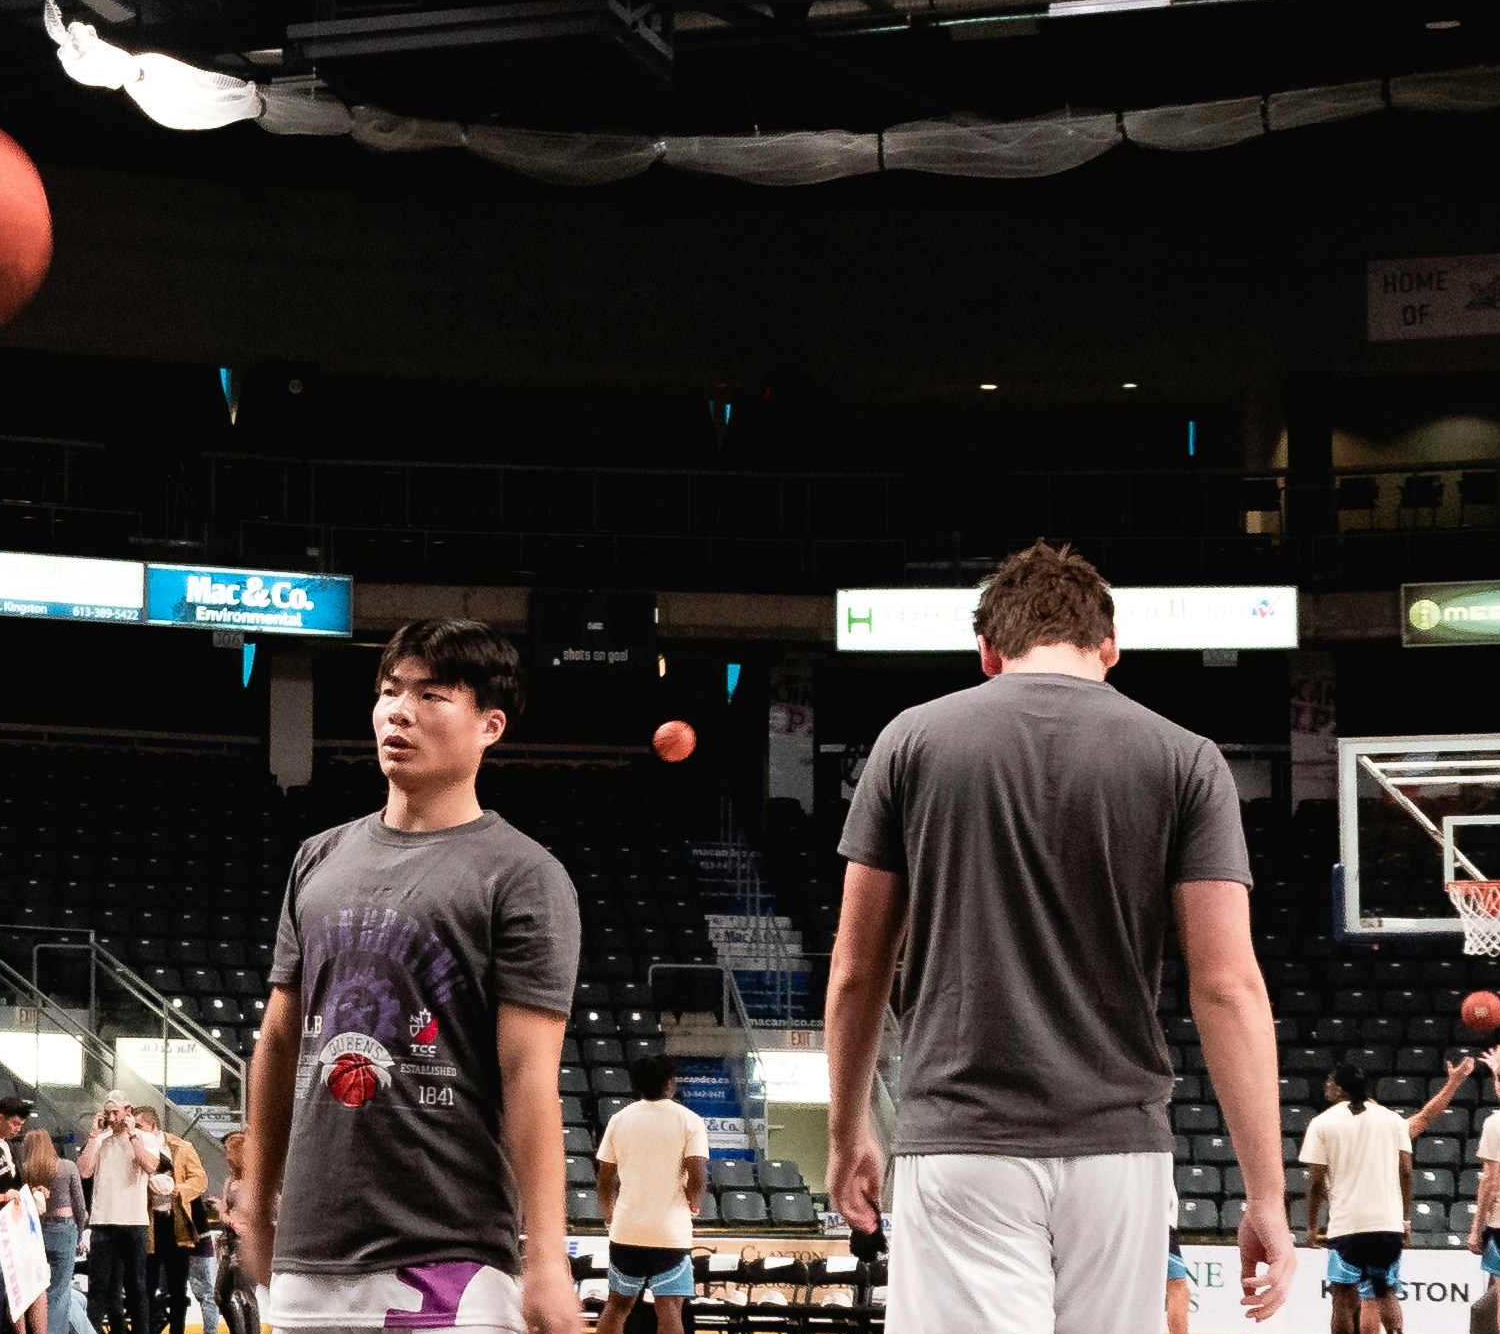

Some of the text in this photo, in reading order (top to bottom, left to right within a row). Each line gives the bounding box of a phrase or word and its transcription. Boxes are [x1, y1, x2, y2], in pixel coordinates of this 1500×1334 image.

[1383, 270, 1449, 293] HOME
[1401, 304, 1430, 327] OF
[186, 576, 314, 611] Mac & Co.
[4, 602, 48, 614] Kingston
[72, 606, 139, 620] 613-389-5422
[195, 606, 303, 628] Environmental
[593, 650, 605, 661] on
[608, 649, 629, 664] goal
[305, 1015, 323, 1035] LB
[328, 1036, 384, 1059] QUEENS
[410, 1044, 438, 1054] TCC
[790, 1032, 811, 1046] EXIT
[399, 1065, 458, 1077] ESTABLISHED
[418, 1086, 455, 1106] 1841
[707, 1119, 740, 1131] & Co.
[1321, 1280, 1470, 1303] KSTON
